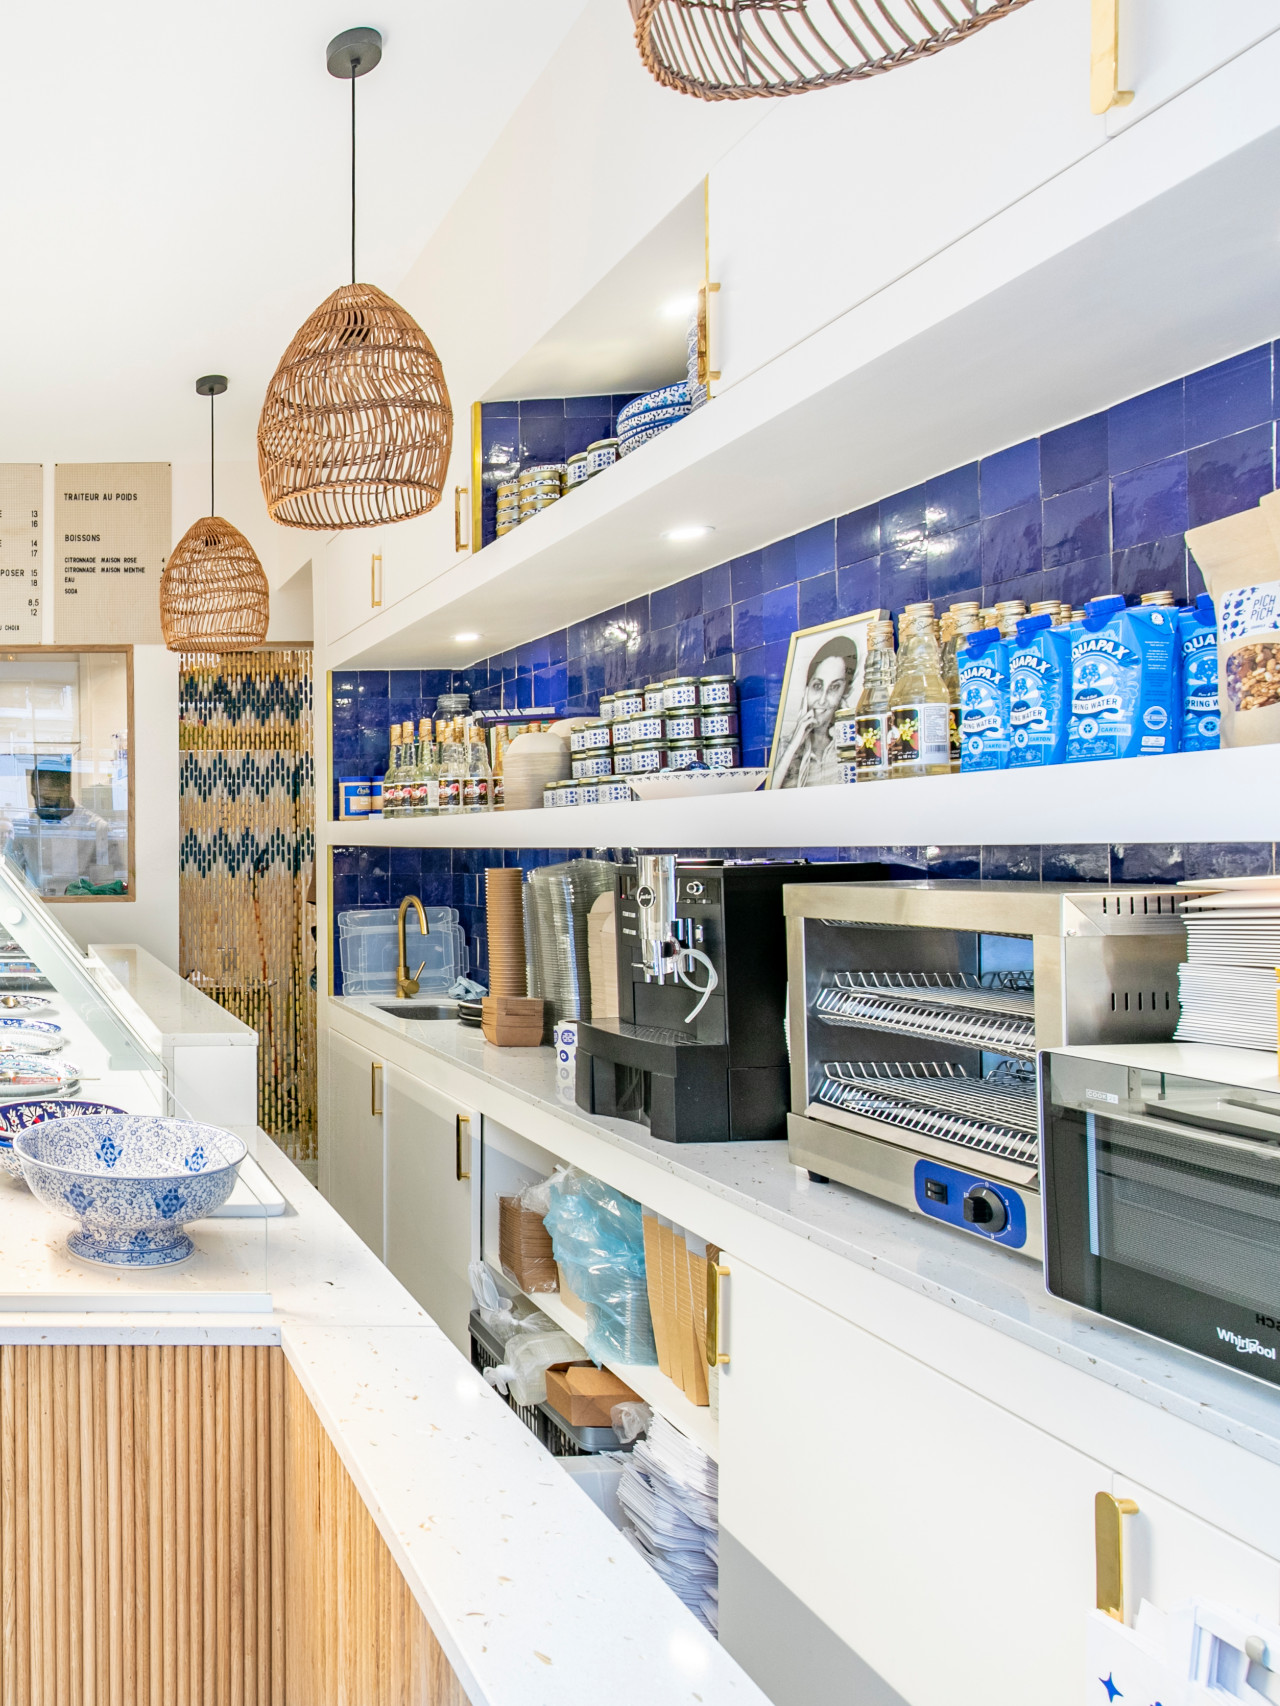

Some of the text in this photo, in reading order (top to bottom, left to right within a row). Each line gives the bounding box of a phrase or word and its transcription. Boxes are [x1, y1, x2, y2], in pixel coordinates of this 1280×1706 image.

[63, 492, 138, 501] TRAITEUR AU POIDS
[31, 510, 39, 518] 13
[31, 519, 39, 528] 16
[64, 534, 101, 542] BOISSONS
[31, 539, 38, 547] 14
[31, 549, 38, 557] 17
[64, 556, 96, 564] CITRONNADE
[31, 569, 38, 577] 15
[64, 566, 96, 574] CITRONNADE
[100, 566, 121, 574] MAISON
[123, 566, 145, 574] MENTHE
[31, 579, 38, 587] 18
[1253, 594, 1276, 609] PICH
[30, 608, 38, 616] 12
[1072, 639, 1130, 662] QUAPAX
[960, 666, 1005, 685] QUAPAX
[1090, 697, 1118, 709] WATER
[1022, 709, 1043, 720] WATER
[976, 718, 998, 728] WATER
[1216, 1326, 1276, 1360] Whirlpool
